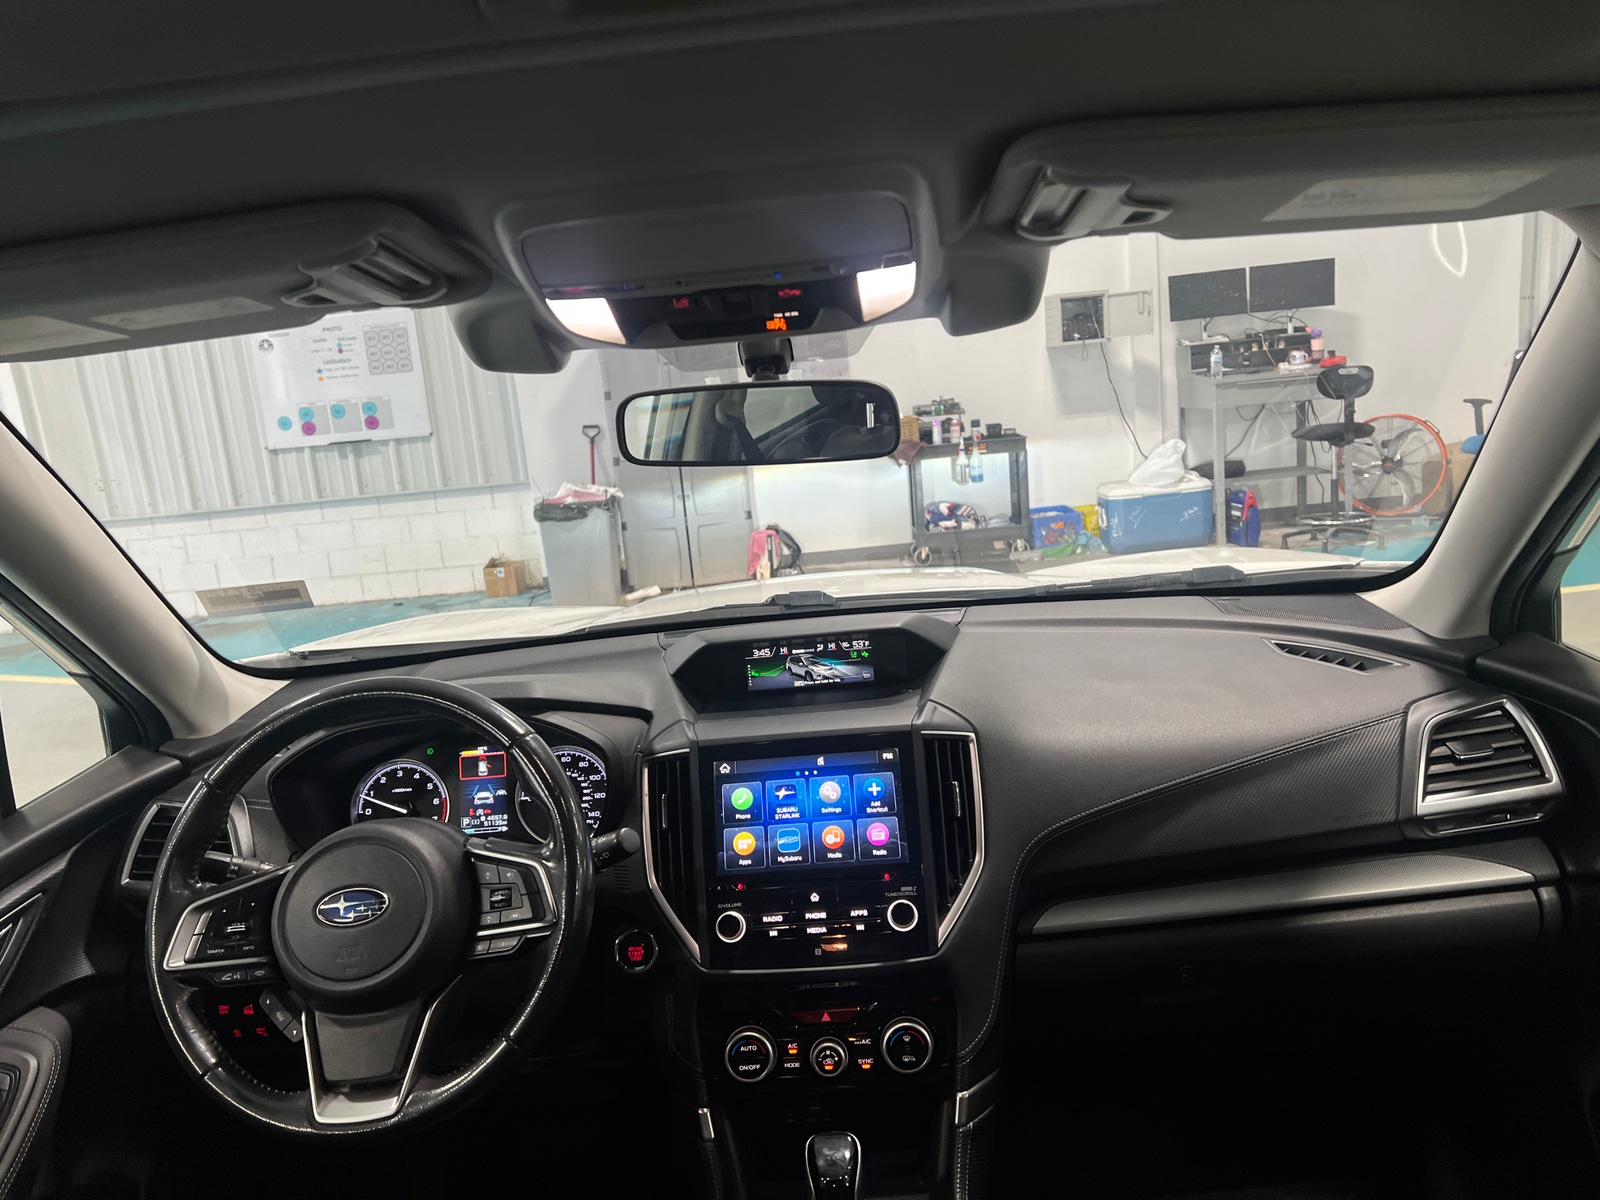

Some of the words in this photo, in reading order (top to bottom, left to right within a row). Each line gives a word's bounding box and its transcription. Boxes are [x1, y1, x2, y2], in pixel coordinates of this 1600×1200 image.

[753, 649, 771, 657] 3:45
[778, 855, 802, 863] MySubaru
[805, 912, 827, 920] PHONE
[850, 909, 868, 917] APPS
[762, 915, 783, 923] RADIO
